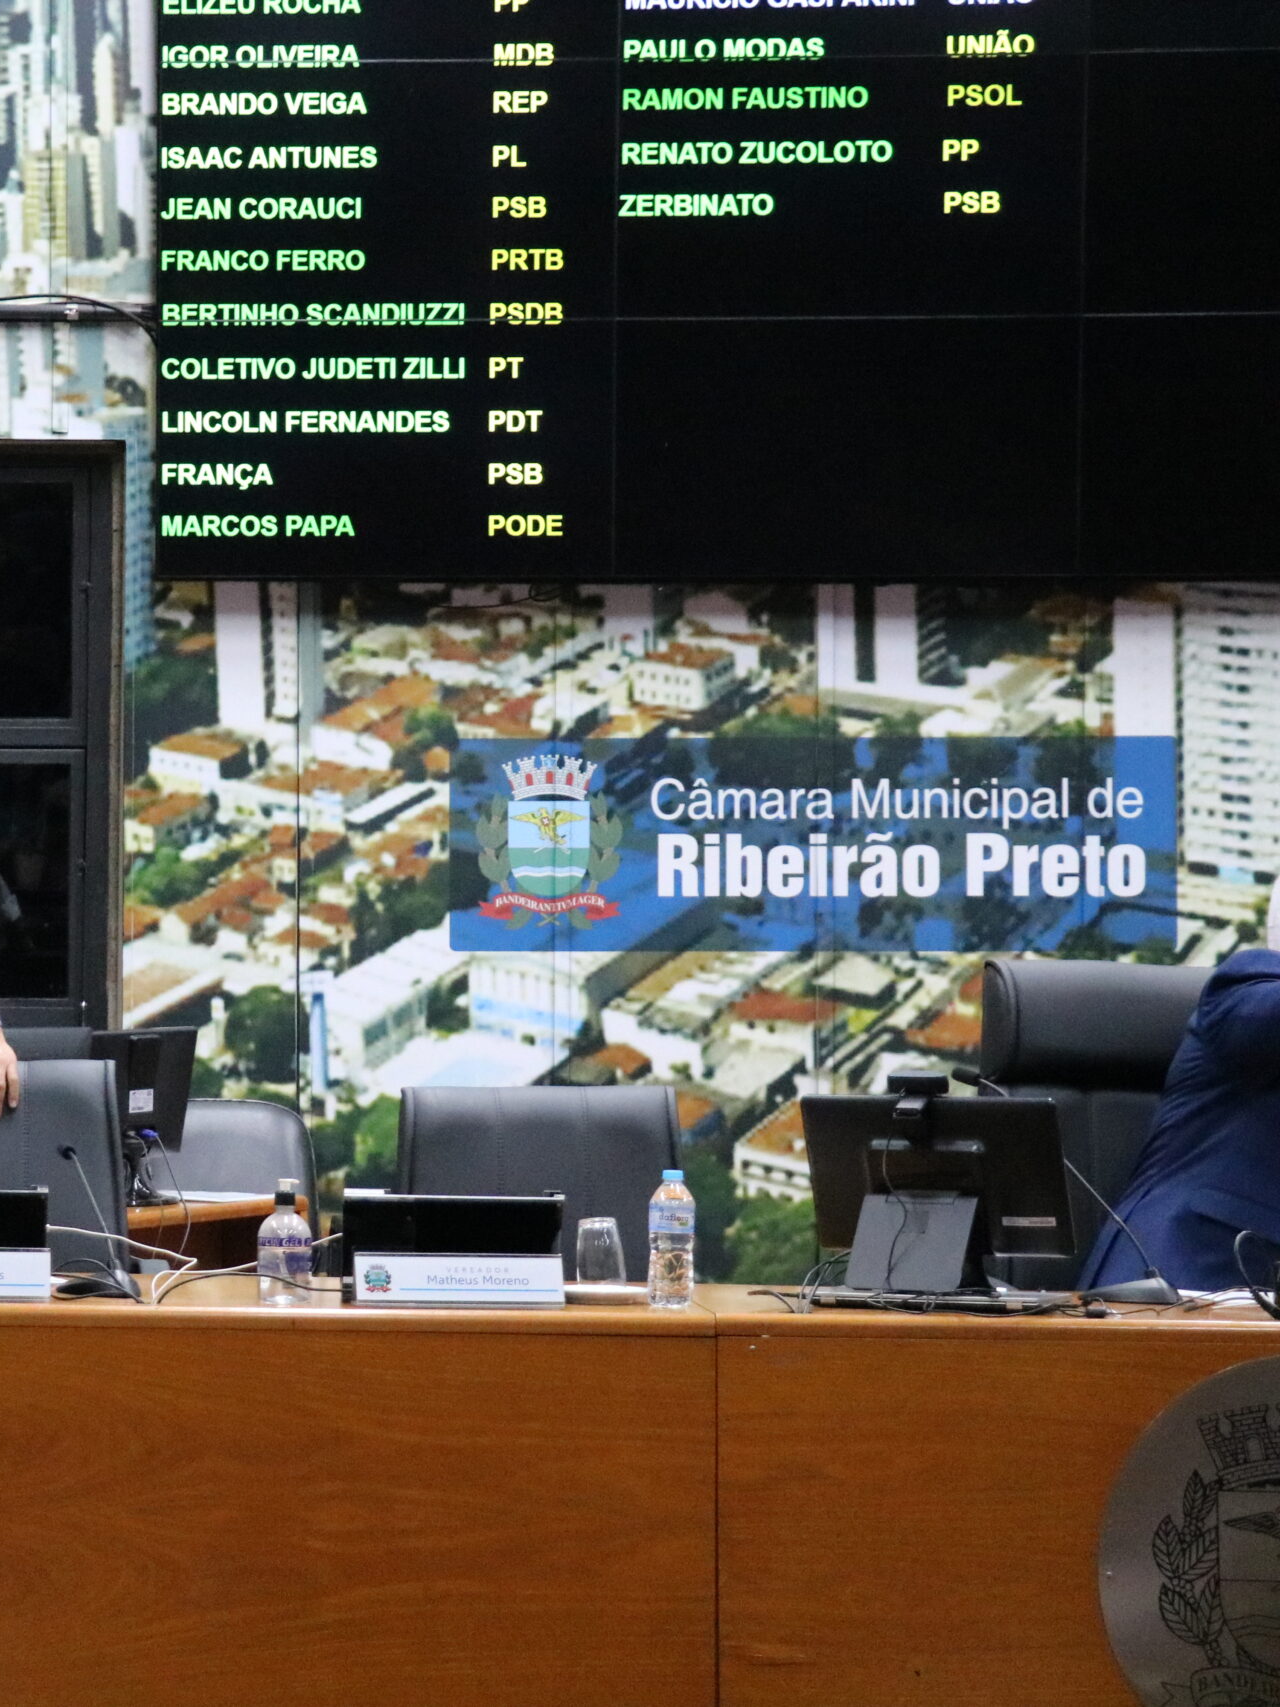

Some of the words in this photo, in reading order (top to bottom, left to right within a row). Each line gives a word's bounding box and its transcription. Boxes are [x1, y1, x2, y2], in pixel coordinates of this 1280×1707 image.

[493, 43, 555, 67] MDB
[623, 38, 717, 63] PAULO
[723, 37, 825, 62] MODAS
[946, 29, 1036, 58] UNIÃO
[162, 45, 228, 69] IGOR
[235, 44, 360, 68] OLIVEIRA
[161, 91, 279, 116] BRANDO
[283, 91, 368, 116] VEIGA
[492, 90, 549, 114] REP
[622, 87, 724, 111] RAMON
[731, 85, 869, 110] FAUSTINO
[947, 83, 1023, 107] PSOL
[160, 146, 243, 170] ISAAC
[247, 145, 378, 170] ANTUNES
[492, 144, 528, 168] PL
[621, 141, 734, 166] RENATO
[738, 139, 894, 165] ZUCOLOTO
[942, 138, 980, 162] PP
[160, 197, 232, 220] JEAN
[238, 196, 362, 220] CORAUCI
[492, 195, 547, 219] PSB
[618, 192, 775, 217] ZERBINATO
[943, 190, 1001, 214] PSB
[161, 249, 270, 272] FRANCO
[276, 249, 366, 272] FERRO
[491, 248, 564, 271] PRTB
[162, 303, 301, 327] BERTINHO
[306, 302, 466, 327] SCANDIUZZI
[489, 302, 564, 326] PSDB
[160, 357, 297, 380] COLETIVO
[301, 356, 397, 380] JUDETI
[401, 356, 466, 380] ZILLI
[488, 356, 525, 379] PT
[161, 410, 278, 434] LINCOLN
[284, 410, 451, 434] FERNANDES
[488, 409, 544, 433] PDT
[161, 462, 274, 491] FRANÇA
[487, 462, 544, 486] PSB
[161, 514, 279, 537] MARCOS
[285, 514, 356, 537] PAPA
[488, 514, 564, 537] PODE
[650, 777, 834, 821] Câmara
[851, 776, 1070, 829] Municipal
[1086, 778, 1145, 818] de
[656, 831, 941, 898] Ribeirão
[965, 832, 1148, 898] Preto
[427, 1274, 479, 1285] Matheus
[482, 1275, 530, 1286] Moreno
